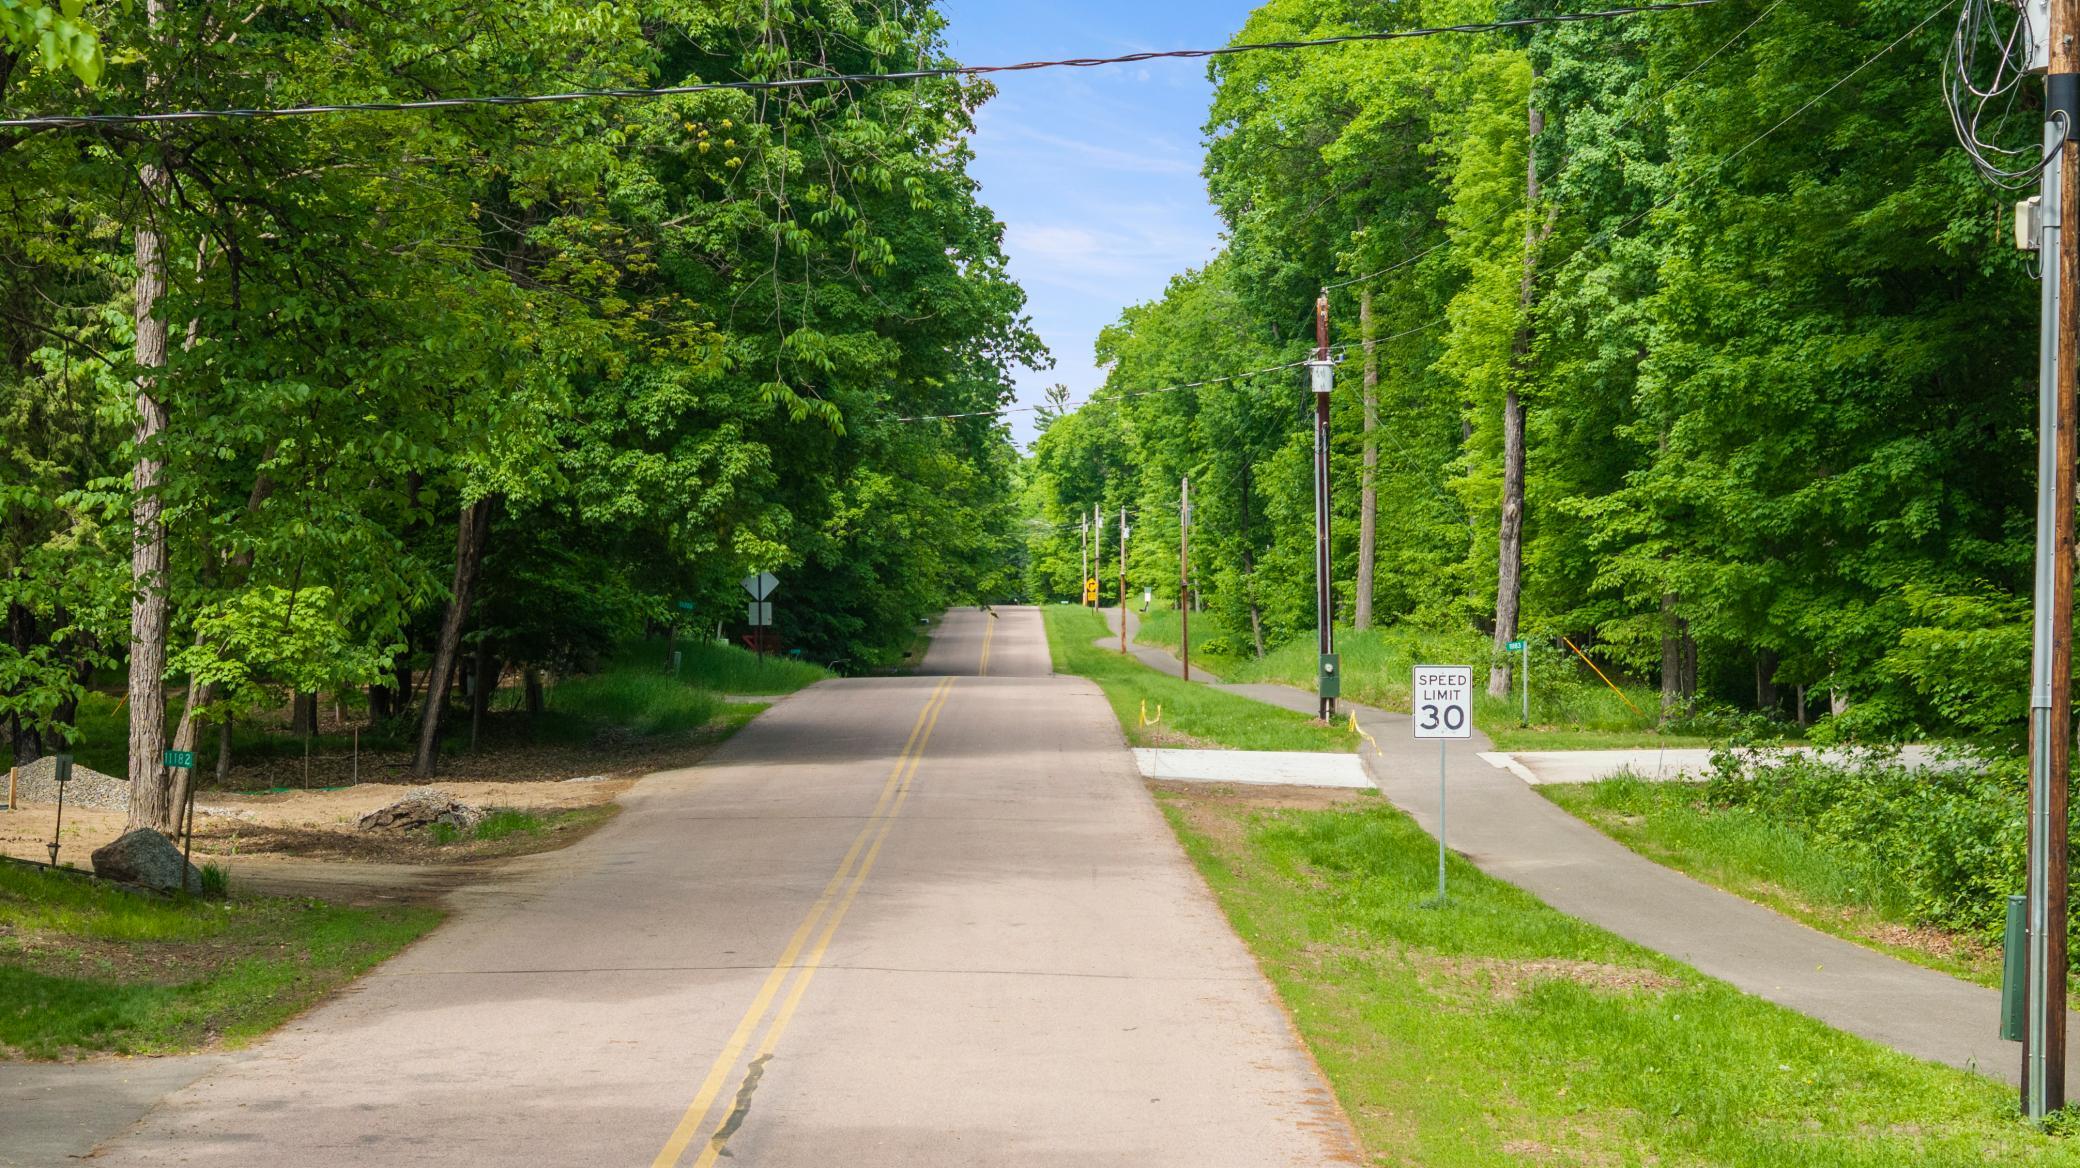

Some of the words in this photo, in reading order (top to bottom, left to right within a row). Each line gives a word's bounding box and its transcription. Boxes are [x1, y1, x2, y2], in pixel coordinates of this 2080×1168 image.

[1419, 675, 1467, 686] SPEED
[1424, 690, 1461, 701] LIMIT
[1420, 704, 1465, 731] 30
[164, 752, 191, 765] 11182
